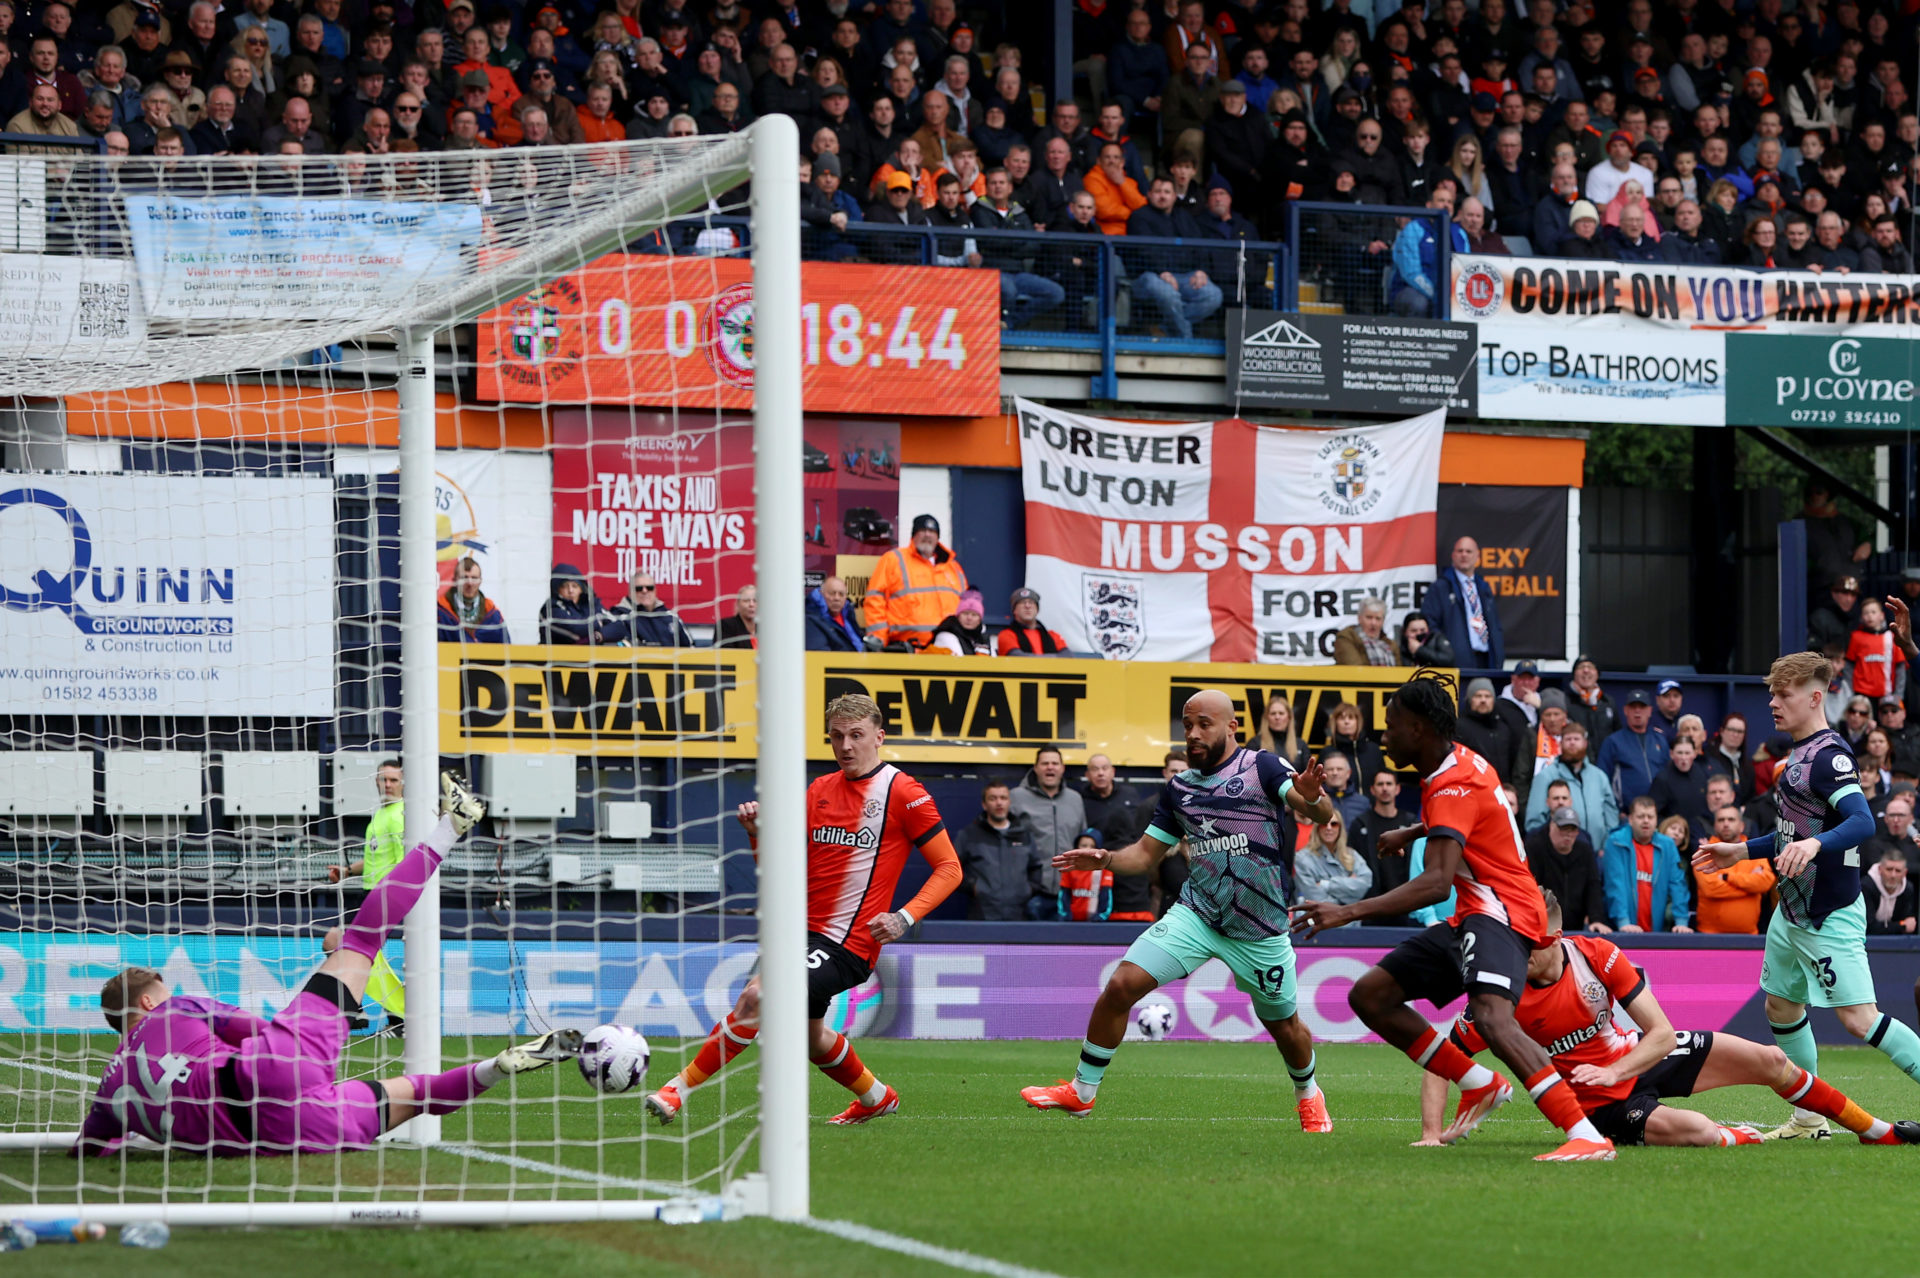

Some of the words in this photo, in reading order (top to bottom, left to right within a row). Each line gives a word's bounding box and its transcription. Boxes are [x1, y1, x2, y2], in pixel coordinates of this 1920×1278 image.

[183, 205, 247, 221] Prostate
[310, 208, 367, 225] Support
[372, 211, 420, 228] Group
[251, 253, 297, 264] DETECT
[302, 253, 355, 265] PROSTATE
[1511, 266, 1621, 315] COME
[1631, 272, 1679, 321] ON
[1687, 276, 1764, 323] YOU
[600, 298, 631, 354] 0
[666, 300, 697, 358] 0
[802, 302, 967, 370] 18:44
[1343, 324, 1360, 334] FOR
[1361, 325, 1377, 335] ALL
[1377, 326, 1400, 336] YOUR
[1401, 327, 1440, 338] BUILDING
[1441, 330, 1469, 340] NEEDS
[1242, 359, 1322, 373] CONSTRUCTION
[1243, 348, 1301, 360] WOODBURY
[1302, 350, 1321, 361] HILL
[1481, 342, 1538, 376] TOP
[1550, 345, 1718, 384] BATHROOMS
[1555, 384, 1577, 395] Take
[1580, 385, 1603, 396] Care
[1790, 409, 1836, 422] 07719
[624, 437, 687, 451] FREENOW
[1021, 410, 1201, 465] FOREVER
[1318, 435, 1348, 460] LUTON
[1353, 434, 1380, 458] TOWN
[597, 472, 681, 512] TAXIS
[684, 476, 717, 512] AND
[1040, 460, 1176, 507] LUTON
[1319, 490, 1360, 516] FOOTBALL
[1361, 488, 1382, 511] CLUB
[572, 509, 654, 547] MORE
[661, 512, 745, 550] WAYS
[1101, 520, 1364, 575] MUSSON
[615, 547, 636, 584] TO
[1488, 575, 1560, 597] TBALL
[91, 618, 231, 633] GROUNDWORKS
[84, 637, 96, 652] &
[101, 636, 203, 653] Construction
[207, 637, 233, 653] Ltd
[42, 686, 92, 700] 01582
[97, 686, 158, 700] 453338
[459, 668, 737, 733] DEWALT
[812, 827, 858, 847] utilita
[1230, 846, 1250, 857] bets
[1253, 965, 1285, 993] 19
[1546, 1024, 1600, 1058] utilita
